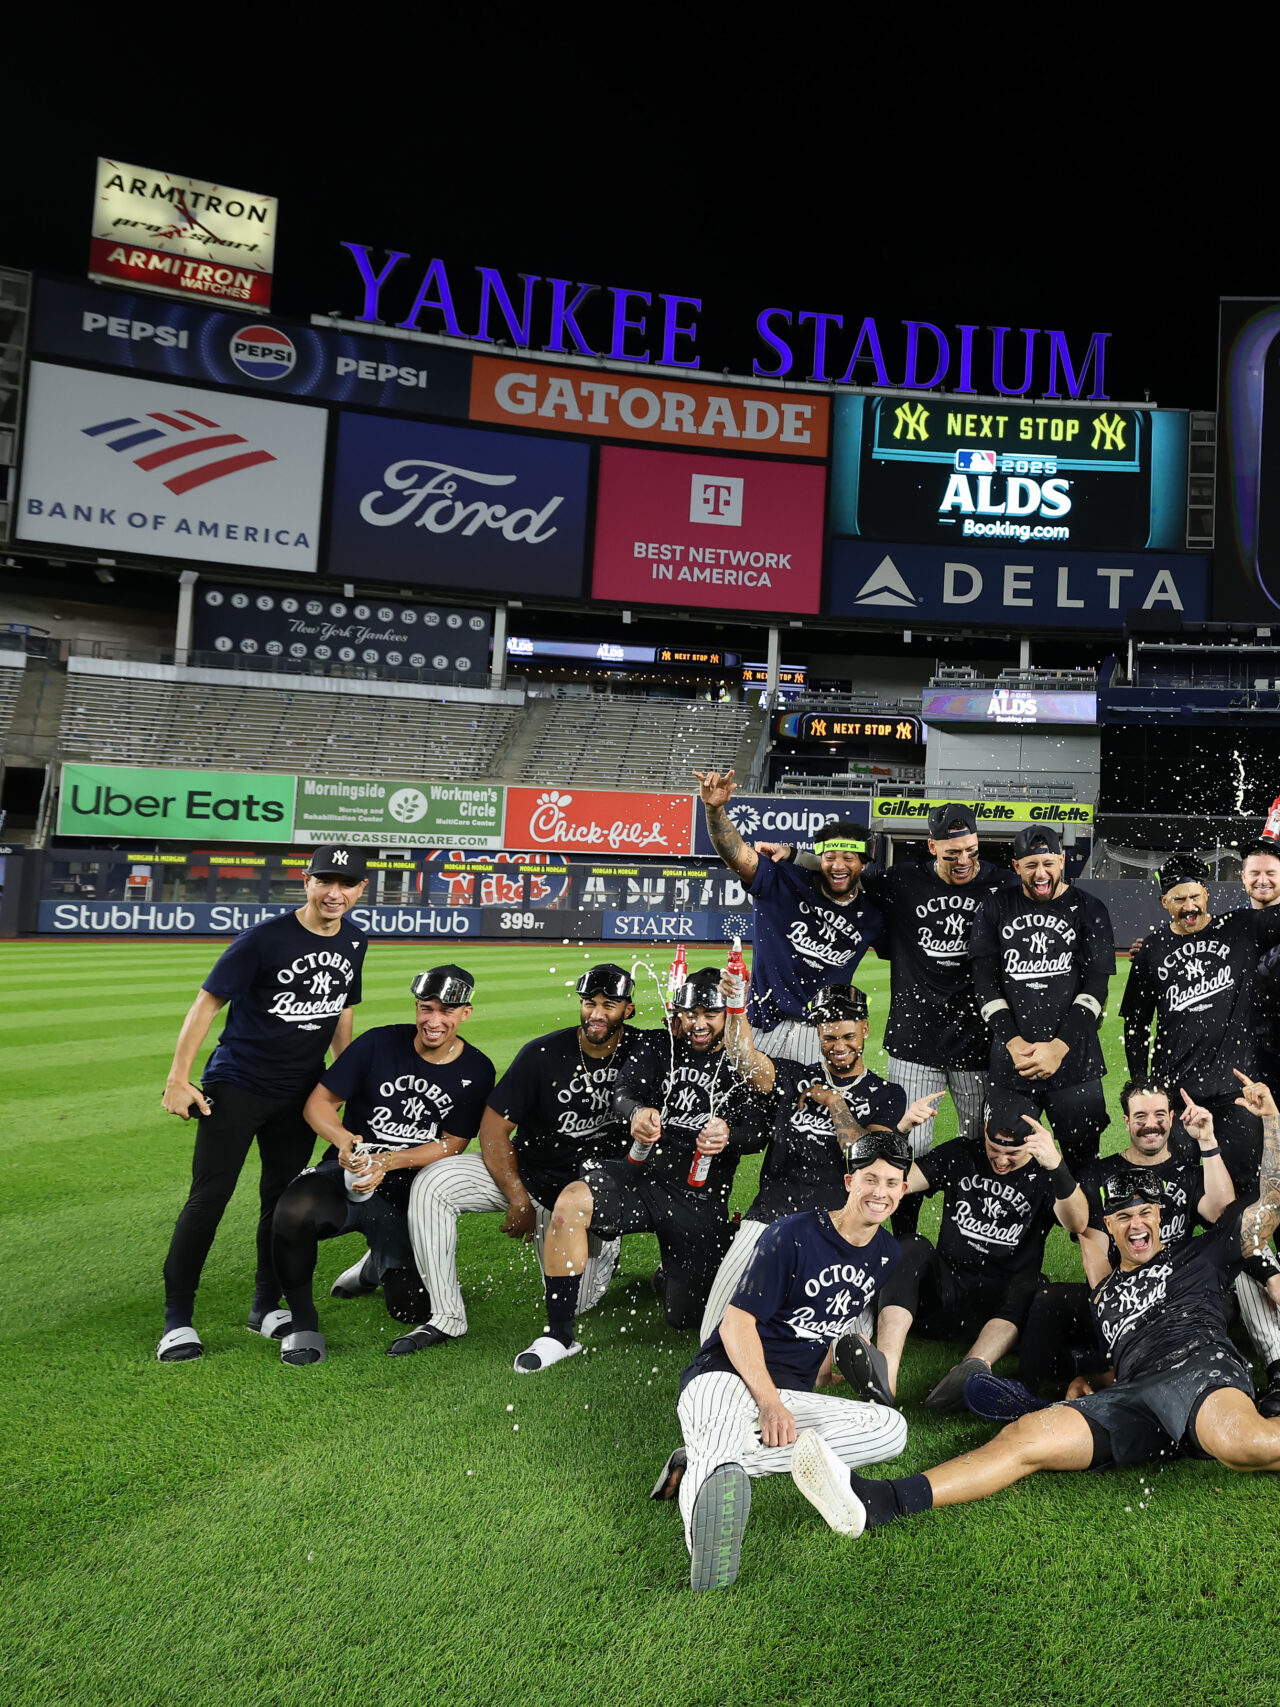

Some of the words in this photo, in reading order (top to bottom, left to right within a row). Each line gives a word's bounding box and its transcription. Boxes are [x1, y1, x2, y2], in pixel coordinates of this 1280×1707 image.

[104, 174, 267, 223] ARMITRON
[107, 248, 254, 289] ARMITRON
[180, 276, 251, 299] WATCHES
[82, 311, 190, 349] PEPSI
[340, 241, 702, 369] YANKEE
[752, 307, 1112, 400] STADIUM
[233, 342, 292, 364] PEPSI
[336, 357, 428, 388] PEPSI
[494, 372, 813, 444] GATORADE
[947, 412, 1006, 439] NEXT
[1019, 415, 1080, 442] STOP
[1002, 459, 1057, 474] 2025
[359, 458, 566, 545] Ford
[938, 474, 1072, 518] ALDS
[27, 499, 117, 526] BANK
[127, 511, 166, 532] OF
[174, 517, 312, 549] AMERICA
[963, 519, 1069, 540] Booking.com
[633, 541, 684, 561] BEST
[688, 545, 792, 570] NETWORK
[651, 563, 673, 580] IN
[677, 565, 772, 588] AMERICA
[942, 562, 1184, 611] DELTA
[288, 619, 320, 633] New
[320, 622, 353, 642] York
[355, 626, 408, 645] Yankees
[987, 699, 1037, 716] ALDS
[833, 723, 861, 735] NEXT
[865, 724, 892, 736] STOP
[72, 785, 175, 818] Uber
[186, 790, 284, 822] Eats
[304, 780, 386, 800] Morningside
[430, 786, 498, 802] Workmen's
[436, 818, 470, 826] MultiCare
[472, 819, 496, 827] Center
[459, 802, 496, 818] Circle
[529, 801, 668, 847] Chick-fil-A
[762, 808, 840, 837] coupa
[1029, 806, 1089, 822] Gillette
[310, 832, 488, 846] WWW.CASSENACARE.COM
[53, 904, 195, 931] StubHub
[351, 909, 469, 934] StubHub
[500, 912, 534, 930] 399
[535, 921, 544, 930] FT
[614, 915, 695, 936] STARR
[1002, 914, 1077, 945] OCTOBER
[786, 921, 856, 967] Baseball
[1004, 949, 1072, 973] Baseball
[1157, 940, 1231, 981] OCTOBER
[1166, 966, 1234, 1011] Baseball
[268, 992, 348, 1016] Baseball
[959, 1174, 1032, 1219] OCTOBER
[951, 1200, 1024, 1246] Baseball
